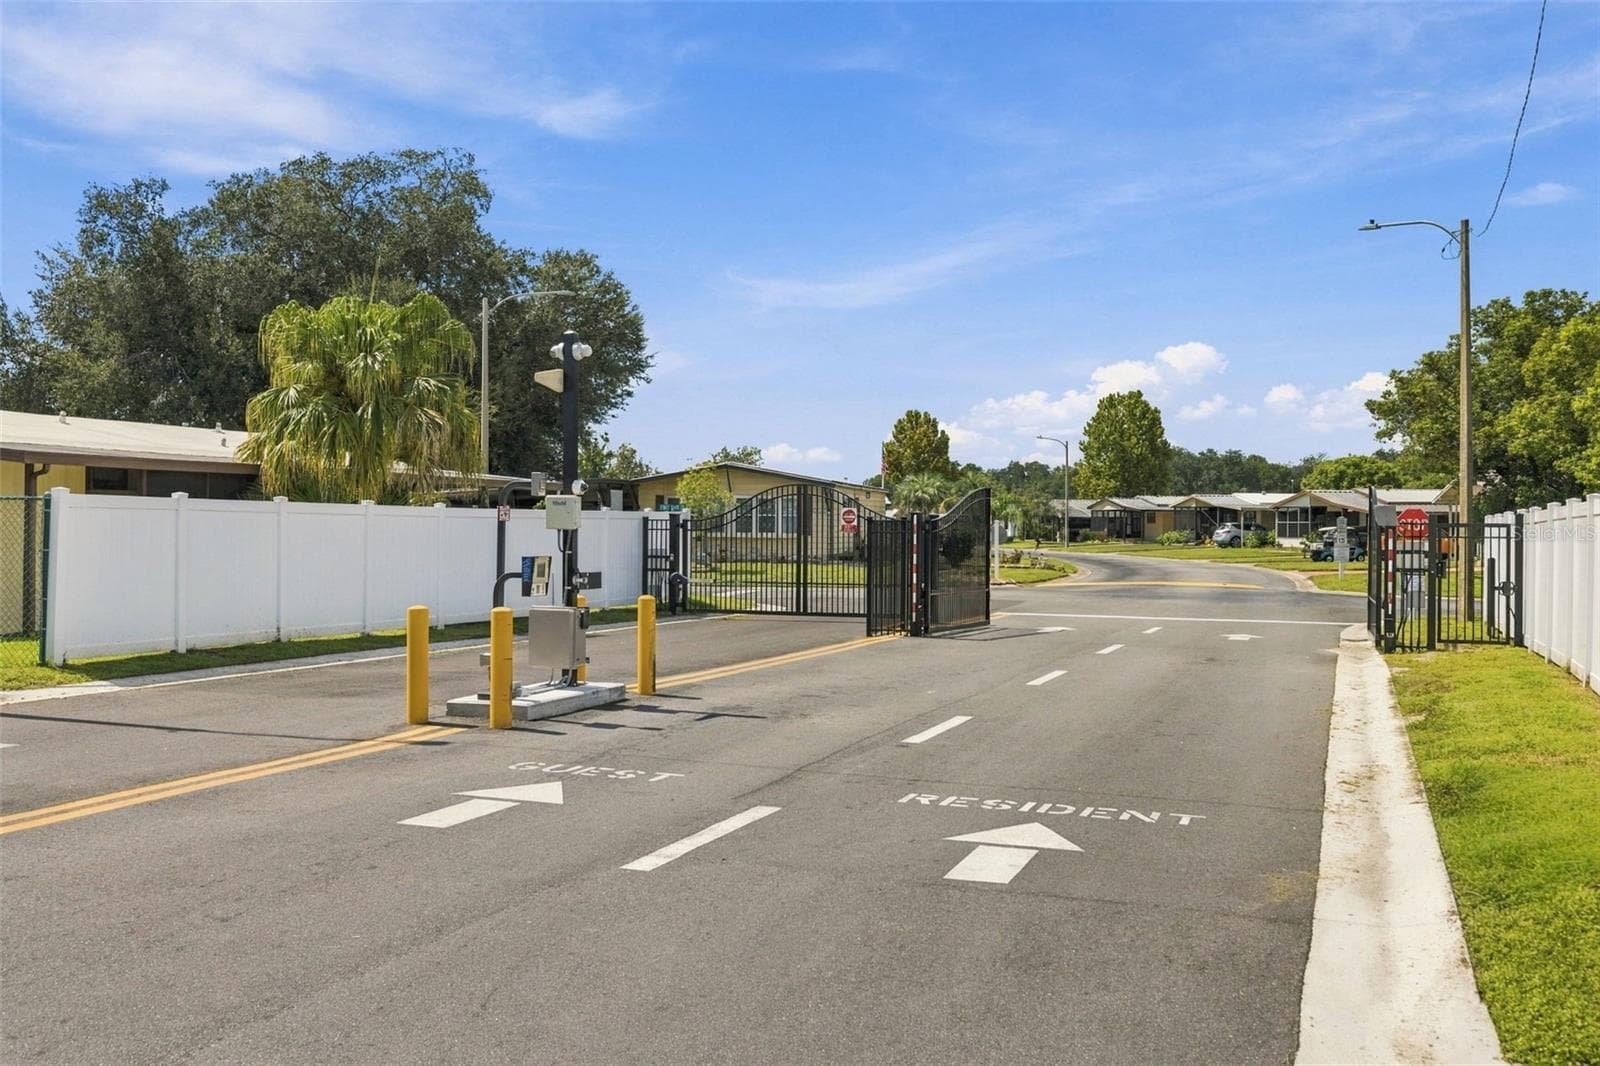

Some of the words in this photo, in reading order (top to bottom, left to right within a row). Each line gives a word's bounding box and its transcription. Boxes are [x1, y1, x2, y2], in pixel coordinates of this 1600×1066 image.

[1398, 518, 1429, 531] STOP
[508, 761, 685, 783] GUEST
[897, 792, 1207, 826] RESIDENT
